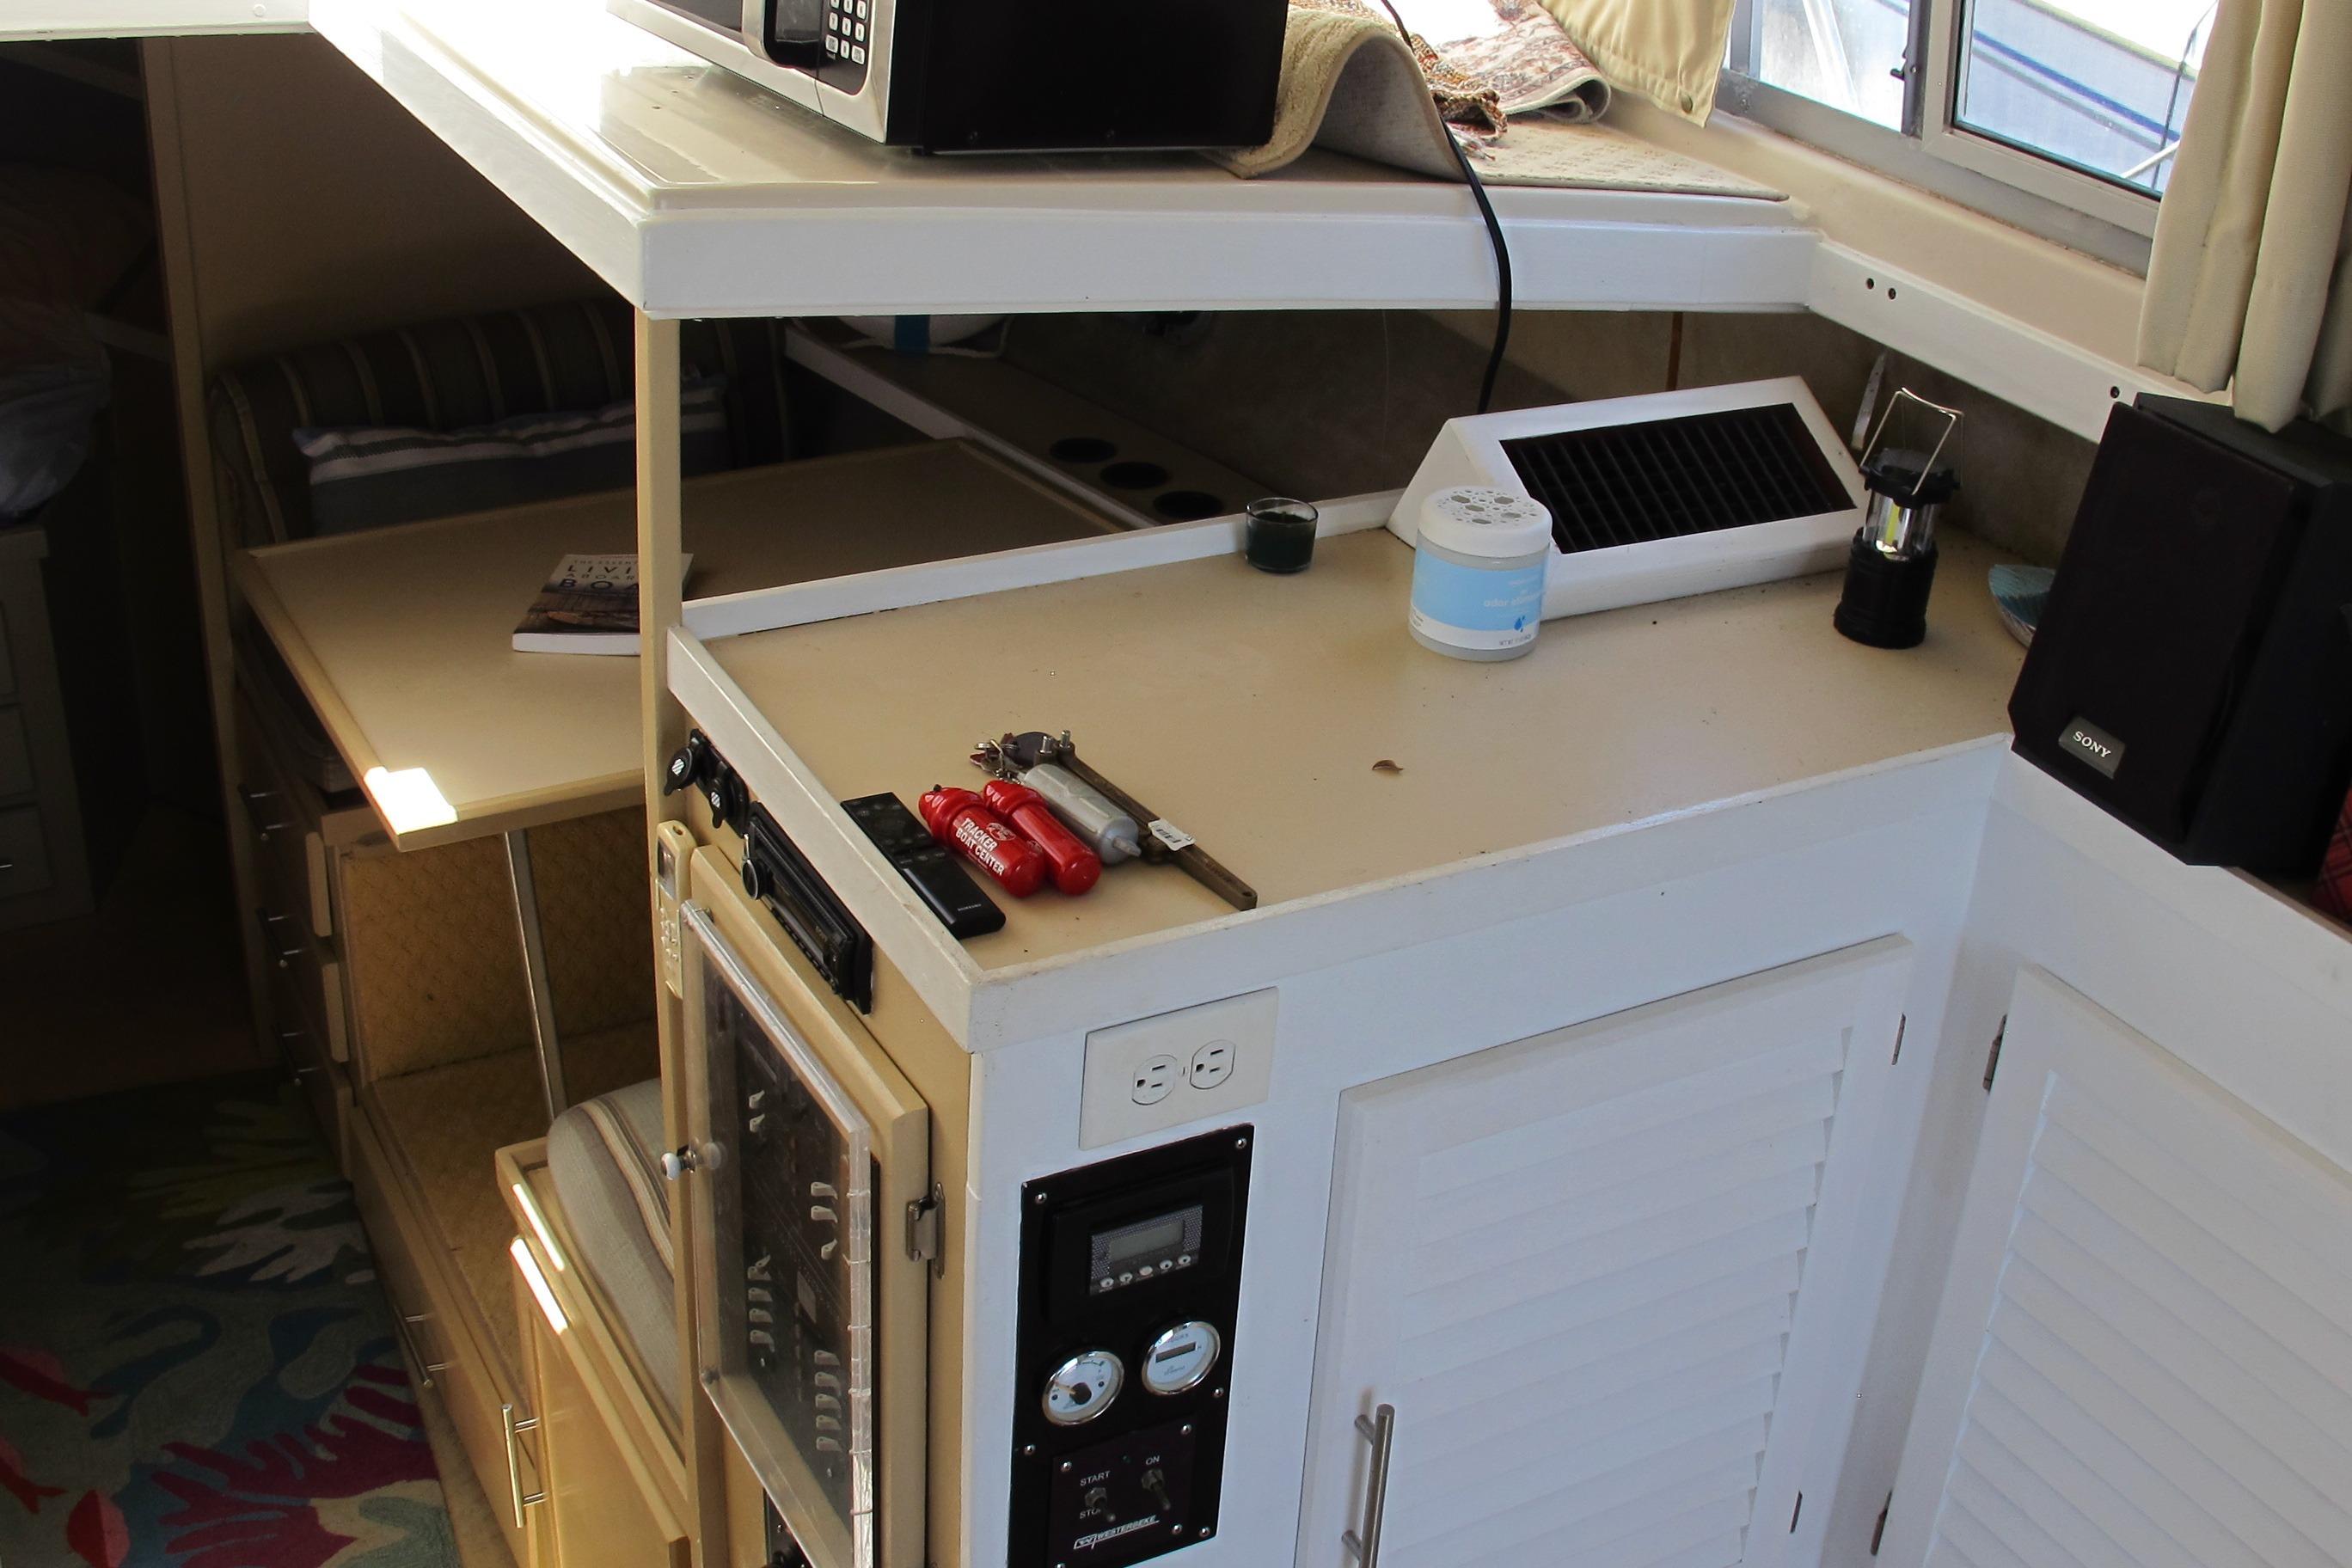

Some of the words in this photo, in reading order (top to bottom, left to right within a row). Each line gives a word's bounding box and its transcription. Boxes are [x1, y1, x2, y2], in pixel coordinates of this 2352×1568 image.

[567, 565, 632, 574] LIVI
[560, 579, 639, 590] BOA
[2073, 731, 2111, 757] SONY
[961, 818, 998, 848] TRACKER
[955, 828, 974, 849] BOAT
[975, 845, 1005, 876] CENTER
[1145, 1455, 1161, 1466] ON
[1080, 1470, 1111, 1486] START
[1079, 1508, 1101, 1520] STO
